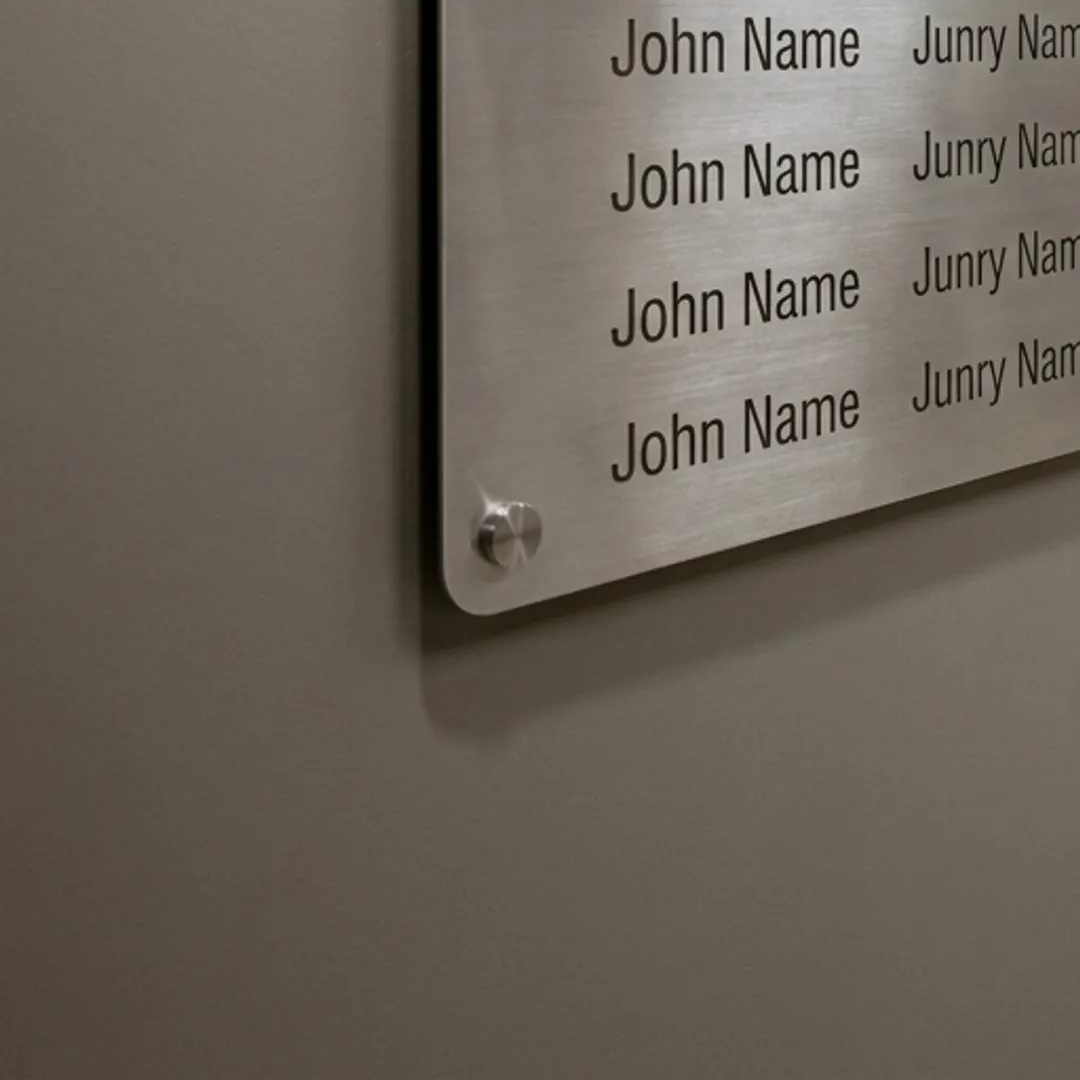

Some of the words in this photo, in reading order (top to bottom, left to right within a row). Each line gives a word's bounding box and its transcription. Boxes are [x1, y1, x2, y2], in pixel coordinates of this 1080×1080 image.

[609, 16, 726, 78] John
[743, 15, 861, 73] Name
[911, 14, 1008, 74] Junry
[609, 147, 725, 213] John
[743, 141, 861, 200] Name
[912, 129, 1008, 185] Junry
[911, 246, 1008, 297] Junry
[609, 280, 725, 349] John
[743, 267, 861, 327] Name
[911, 356, 1008, 413] Junry
[610, 411, 725, 484] John
[743, 388, 861, 455] Name
